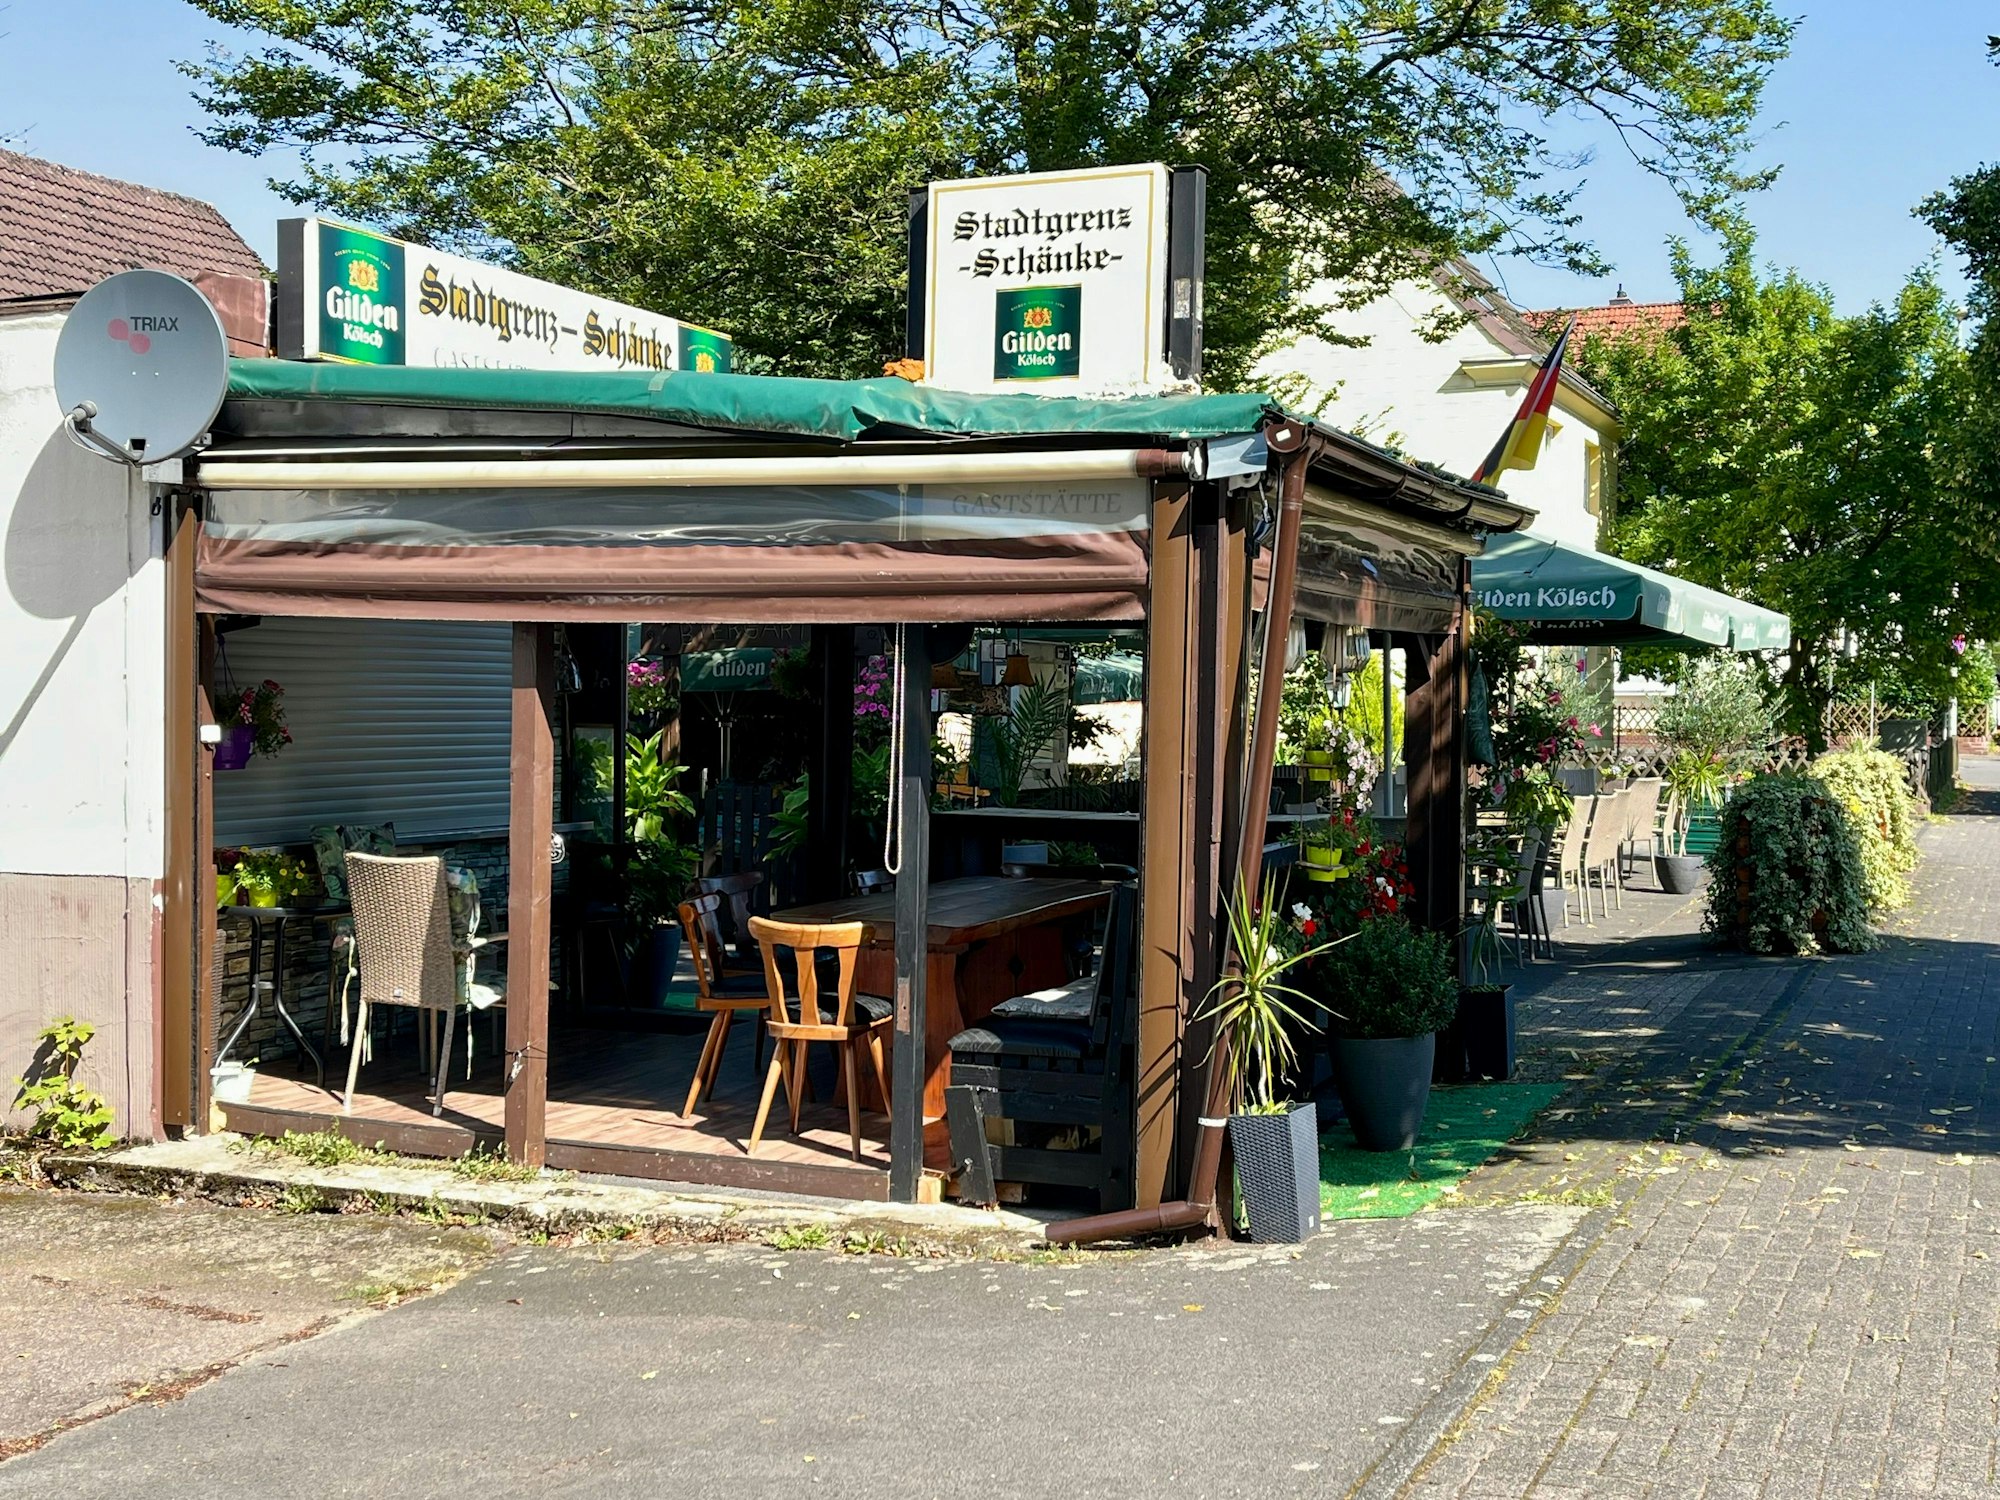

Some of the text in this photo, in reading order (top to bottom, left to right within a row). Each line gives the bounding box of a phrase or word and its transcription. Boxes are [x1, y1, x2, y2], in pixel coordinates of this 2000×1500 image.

[952, 206, 1133, 242] Stadtgrenz
[326, 285, 398, 332] Gilden
[130, 316, 179, 332] TRIAX
[343, 322, 384, 349] Kölsch
[1002, 331, 1071, 354] Gilden
[1017, 353, 1056, 367] Kölsch
[952, 489, 1122, 515] GASTSTÄTTE
[1473, 585, 1617, 609] ilden Kölsch
[712, 660, 766, 677] Gilden
